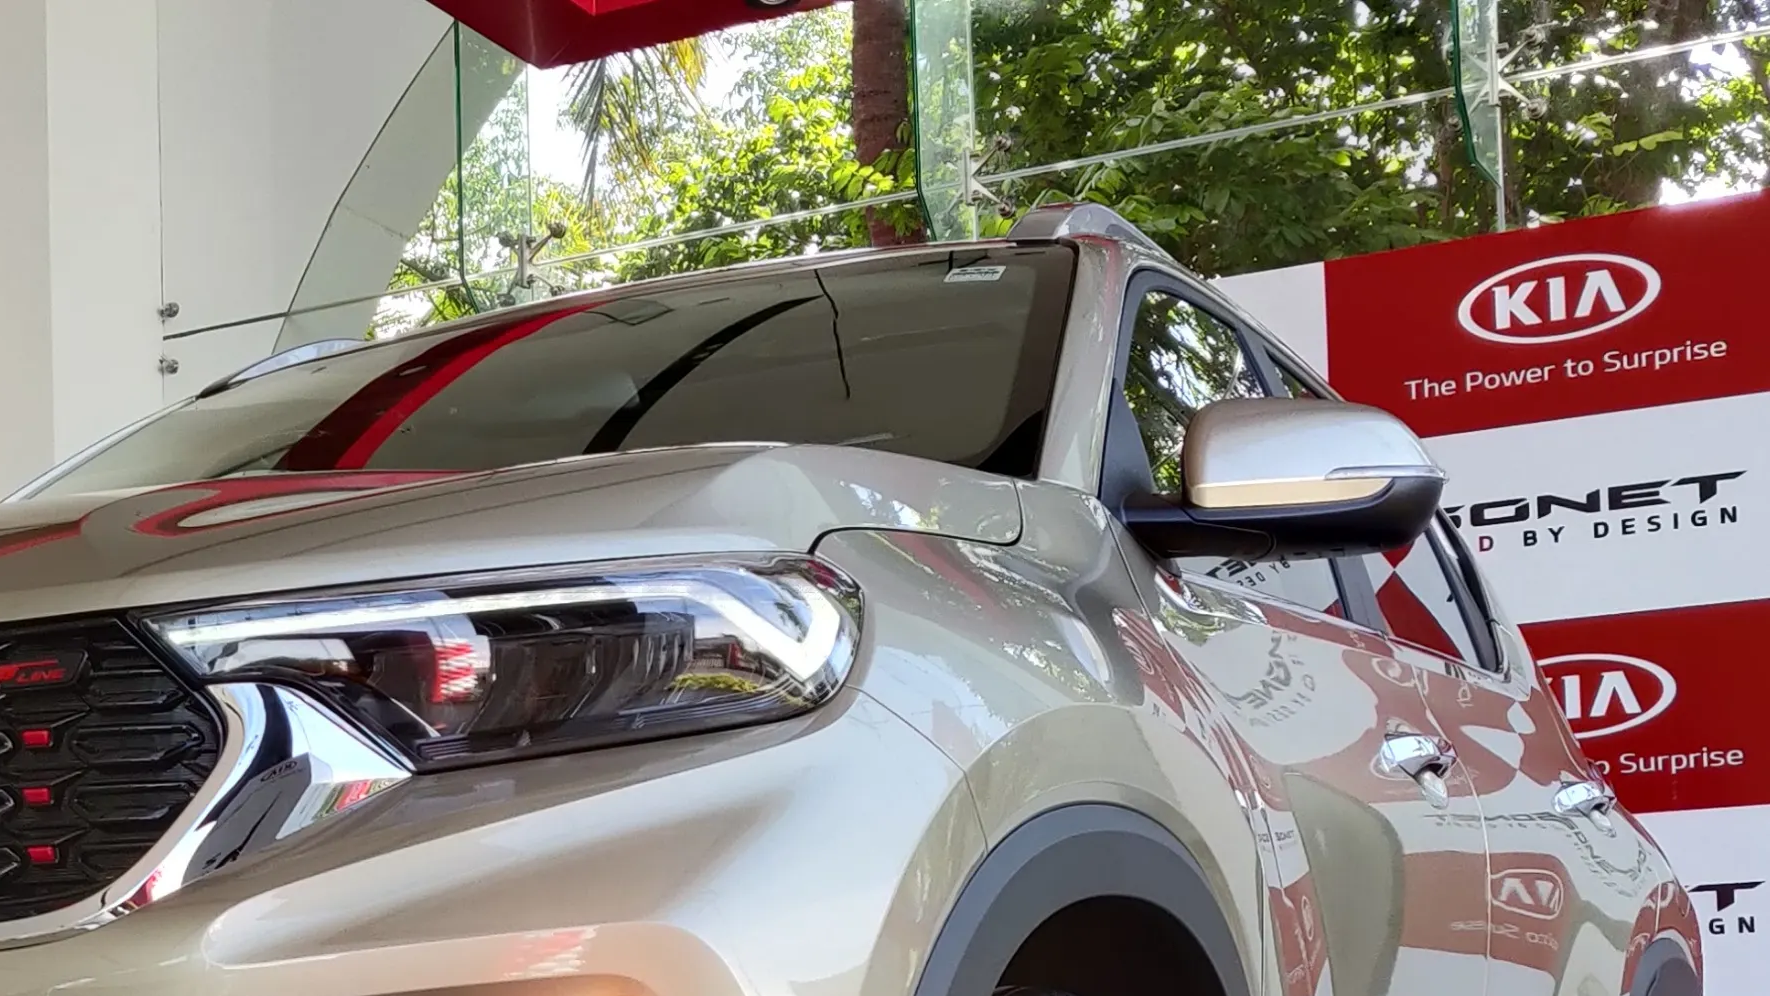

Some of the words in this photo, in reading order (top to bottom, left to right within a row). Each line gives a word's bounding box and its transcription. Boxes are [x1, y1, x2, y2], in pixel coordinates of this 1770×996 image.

[1491, 268, 1627, 330] KIA
[1404, 379, 1457, 400] The
[1465, 363, 1556, 392] Power
[1563, 358, 1594, 379] to
[1602, 340, 1728, 371] Surprise
[1523, 526, 1566, 547] BY
[1593, 505, 1739, 539] DESIGN
[1547, 670, 1642, 720] IA
[1619, 746, 1745, 774] Surprise
